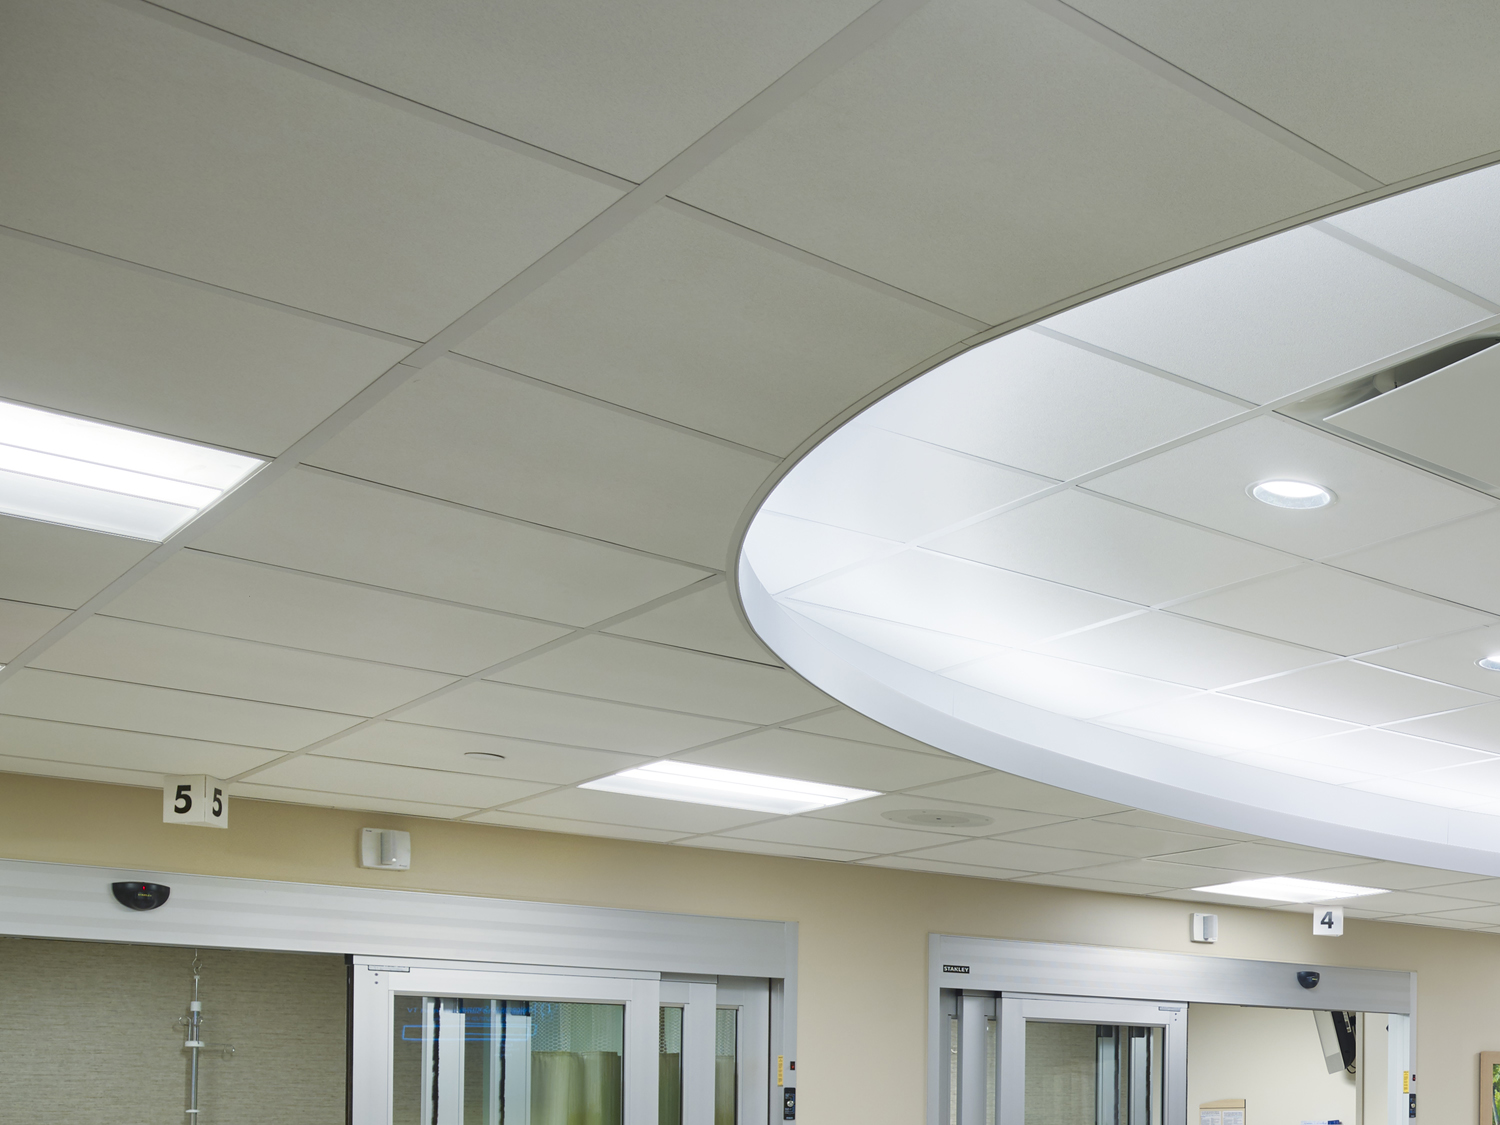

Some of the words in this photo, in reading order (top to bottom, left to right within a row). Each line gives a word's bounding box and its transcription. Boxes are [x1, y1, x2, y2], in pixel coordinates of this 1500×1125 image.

[174, 785, 192, 814] 5
[212, 788, 222, 817] 5
[1320, 911, 1334, 929] 4
